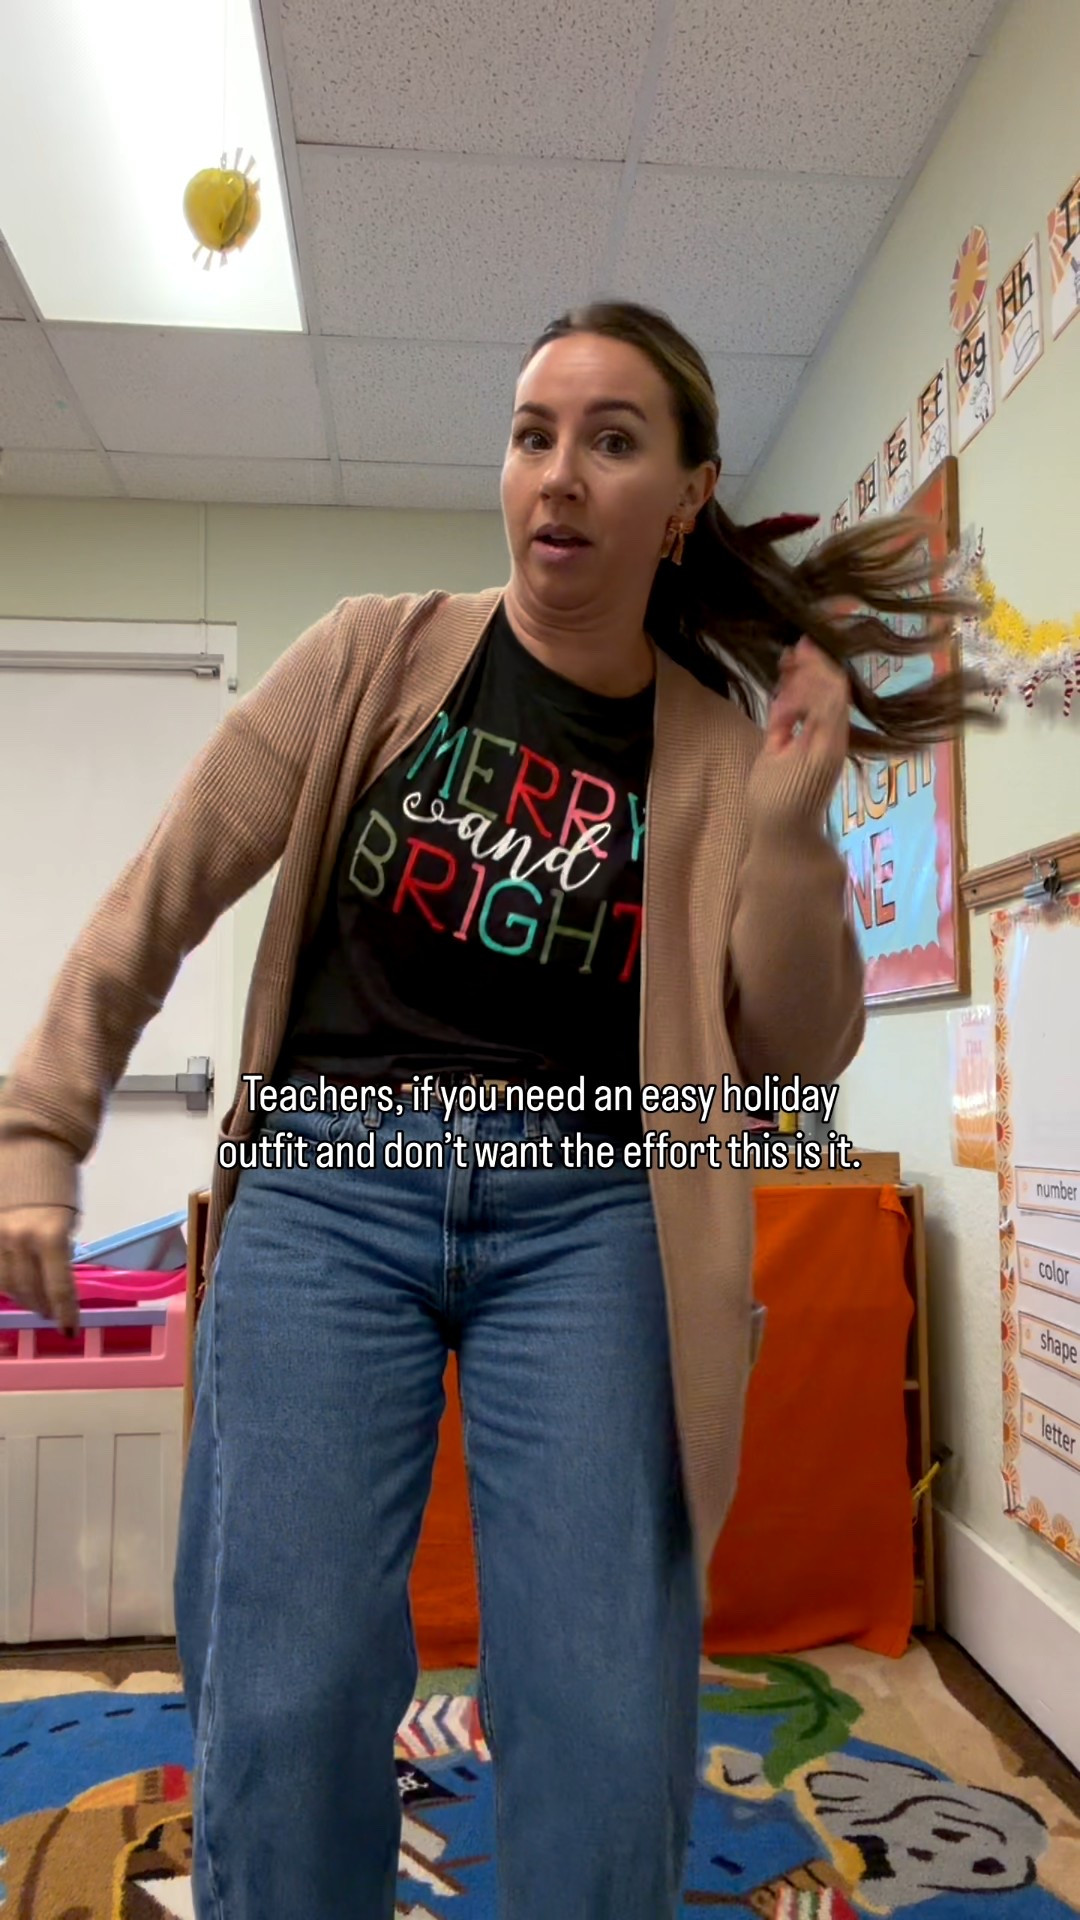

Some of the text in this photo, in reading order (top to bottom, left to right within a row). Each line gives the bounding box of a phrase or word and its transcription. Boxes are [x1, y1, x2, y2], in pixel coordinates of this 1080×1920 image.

[1000, 259, 1034, 332] Hh
[958, 333, 987, 384] Gg
[920, 372, 944, 435] Ff
[887, 436, 907, 477] Ee
[858, 462, 876, 516] Dd
[406, 711, 646, 861] MERRY
[403, 792, 611, 891] and
[350, 810, 643, 982] BRIGHT
[1036, 1180, 1078, 1201] number
[1038, 1259, 1070, 1286] color
[1040, 1329, 1078, 1364] shape
[1041, 1414, 1076, 1454] letter
